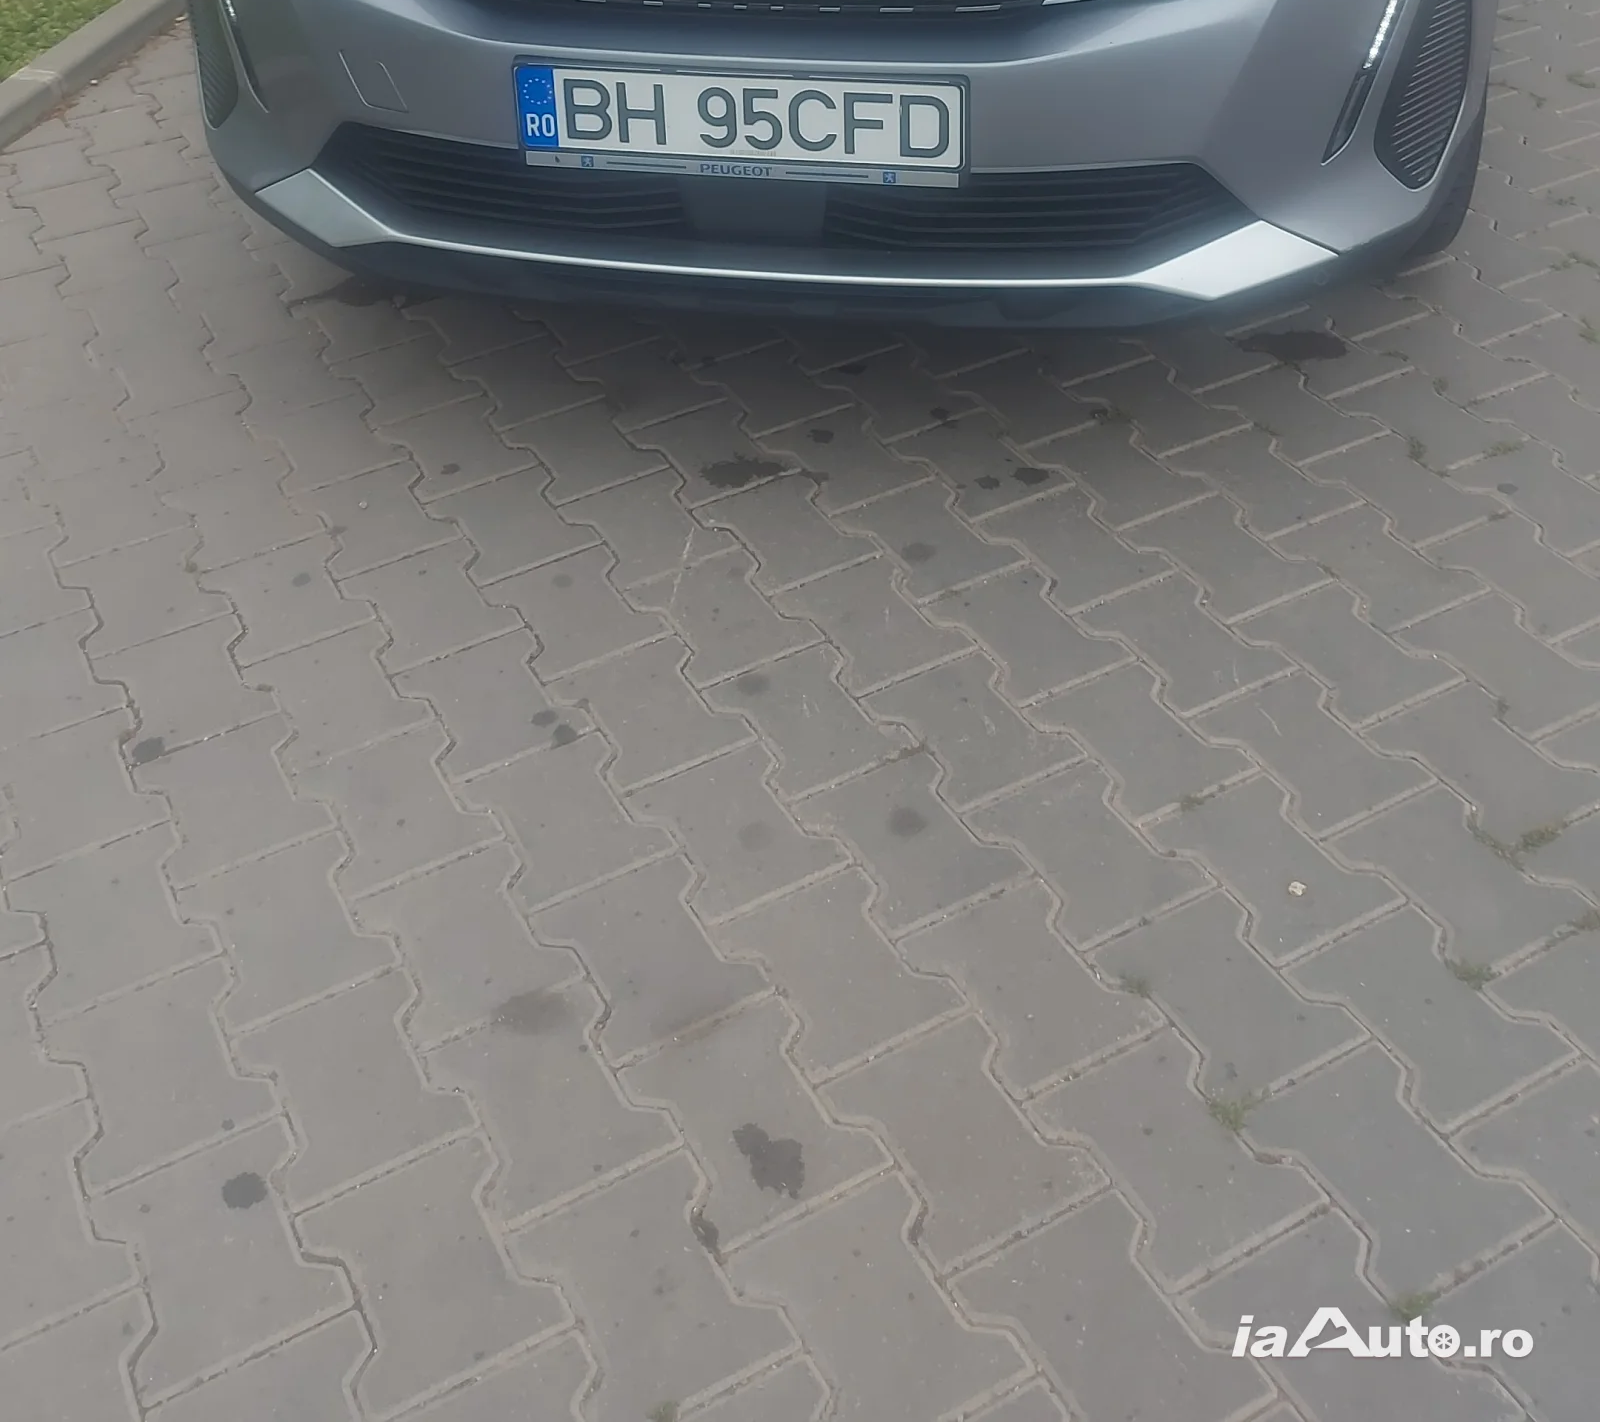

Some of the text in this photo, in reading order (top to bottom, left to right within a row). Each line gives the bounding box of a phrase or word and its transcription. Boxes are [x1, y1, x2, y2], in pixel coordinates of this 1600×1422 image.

[526, 113, 556, 137] RO
[563, 78, 950, 158] BH 95CFD
[700, 163, 772, 177] PEUGEOT
